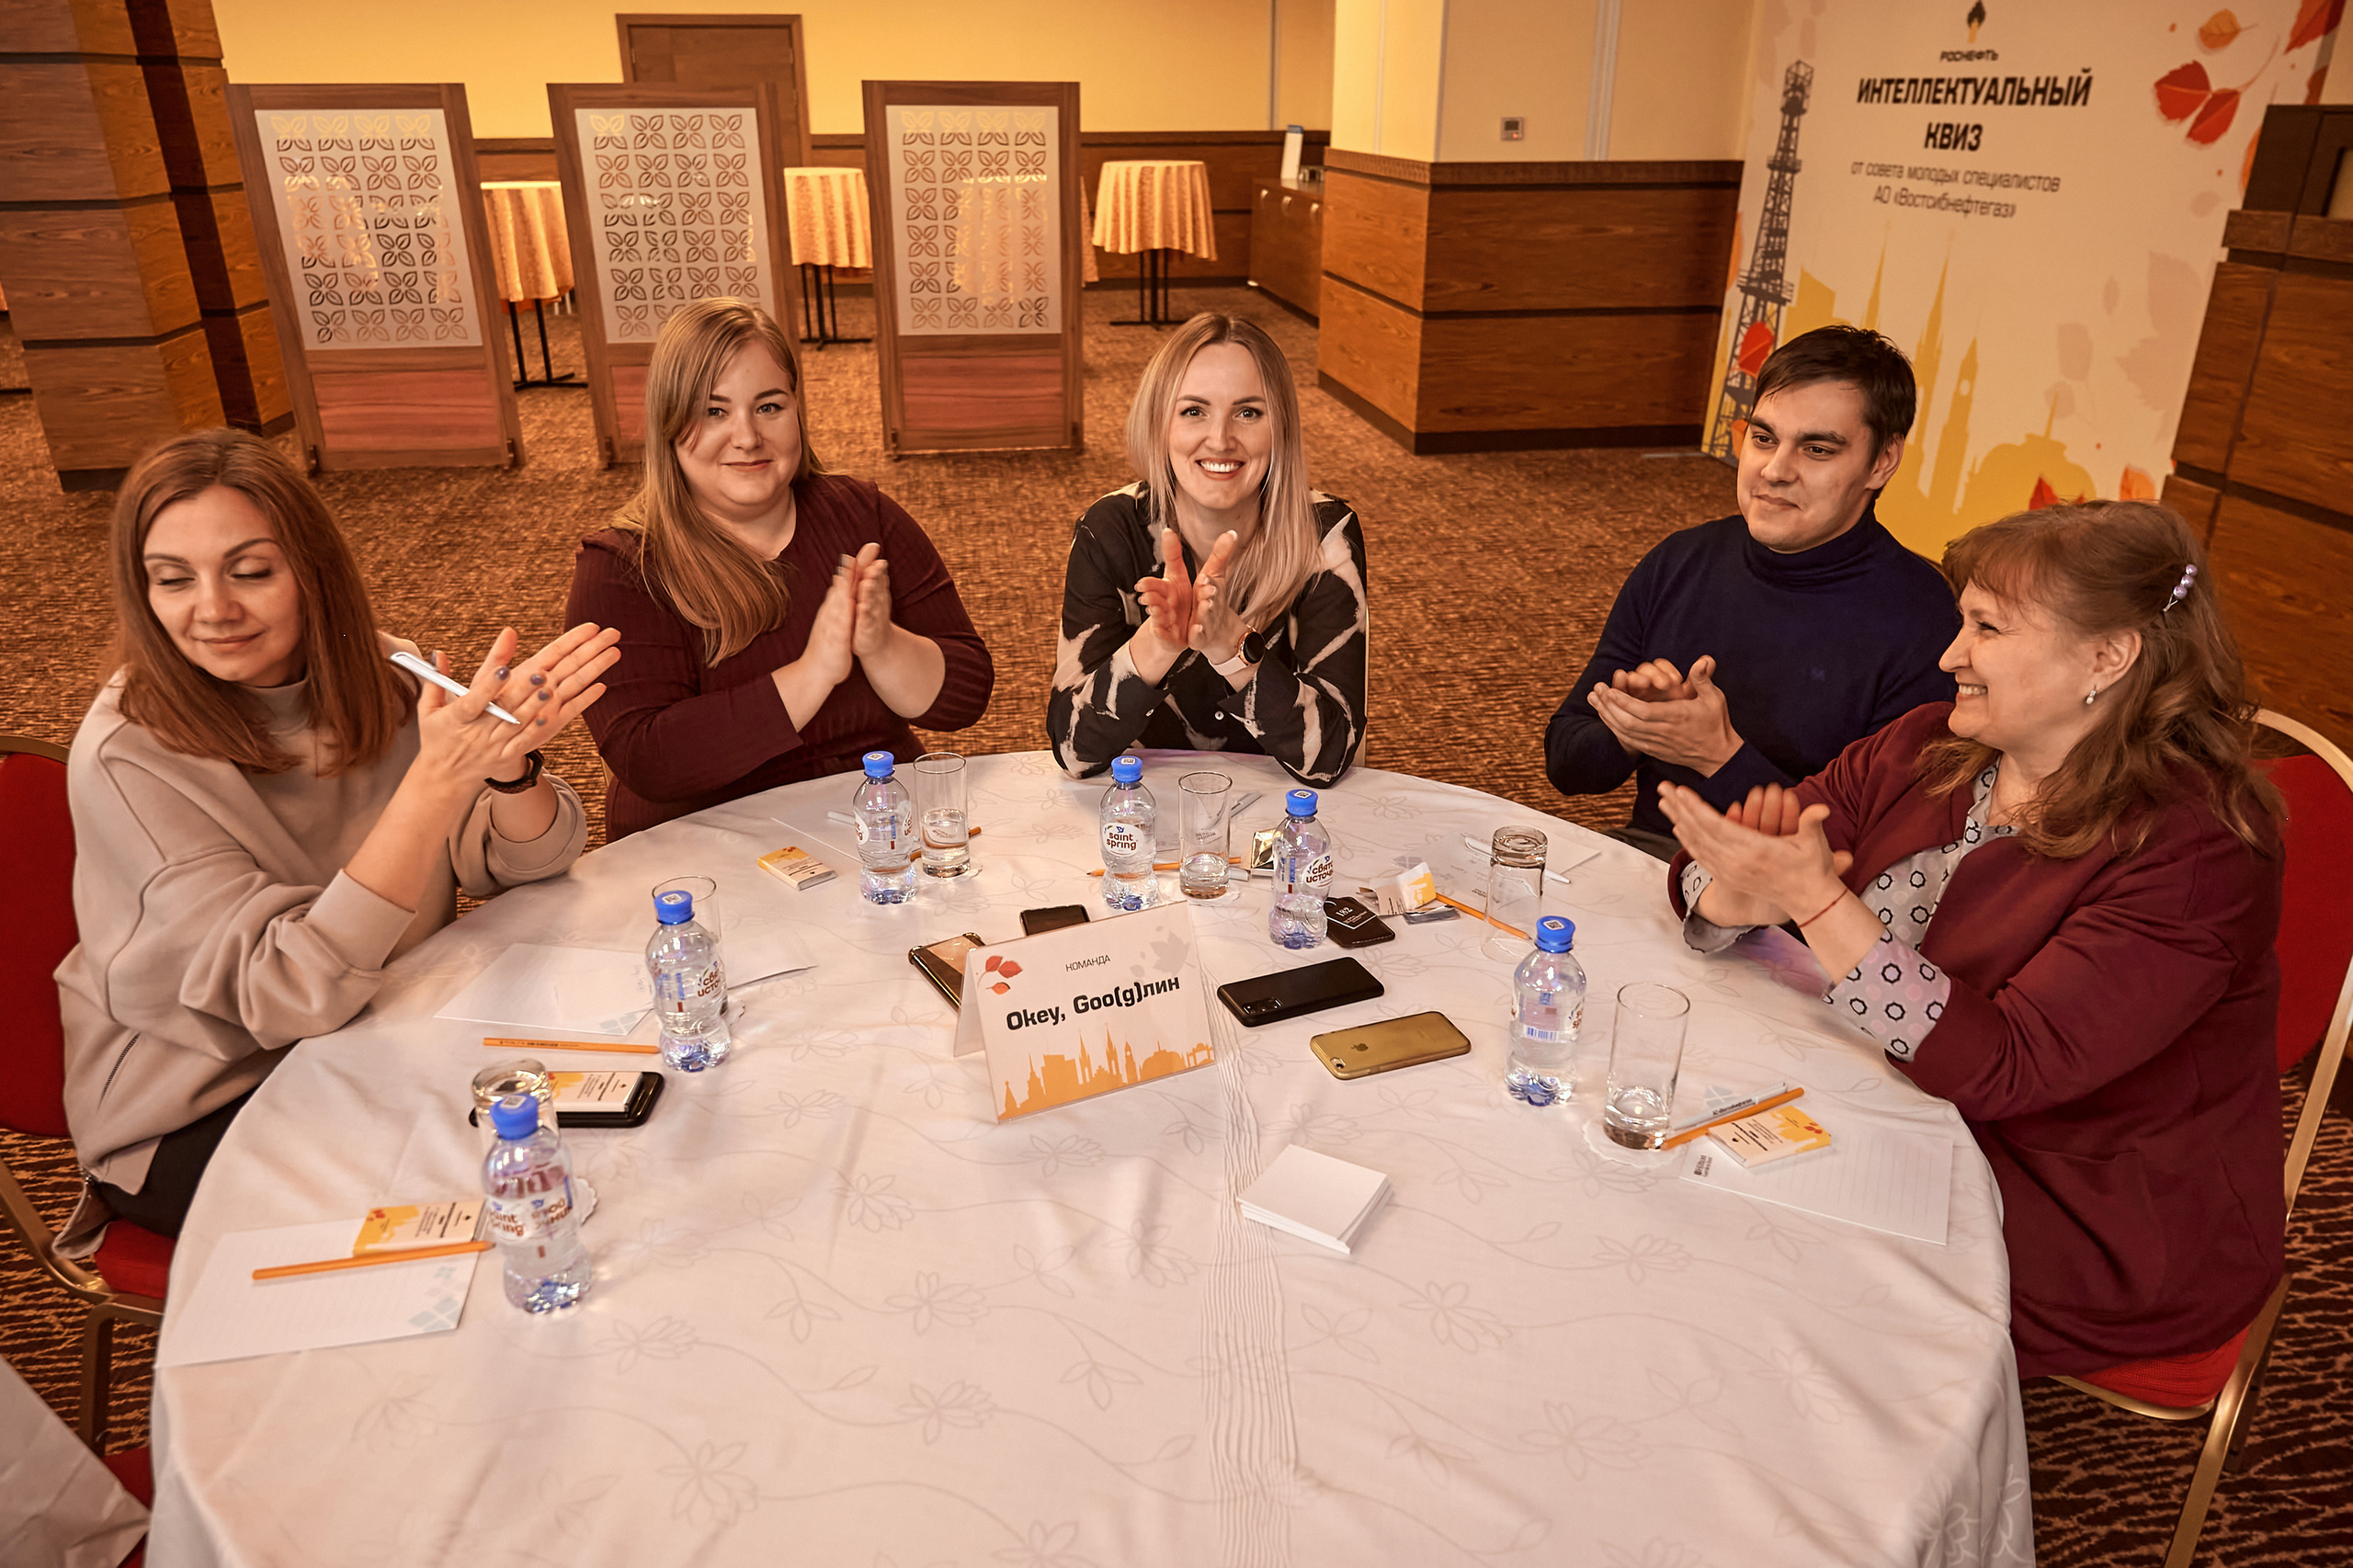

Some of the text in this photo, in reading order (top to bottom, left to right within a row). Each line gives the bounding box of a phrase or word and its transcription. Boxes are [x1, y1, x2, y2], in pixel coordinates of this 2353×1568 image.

[1939, 50, 1999, 62] РОСНЕФТЬ
[1857, 67, 2093, 107] ИНТЕЛЛЕКТУАЛЬНЫЙ
[1924, 122, 1983, 152] КВИЗ
[1850, 161, 2061, 193] от совета молодых специалистов
[1873, 185, 2017, 219] АО «Востсибнефтегаз»
[1107, 838, 1137, 851] spring
[1108, 832, 1134, 842] saint
[1065, 954, 1111, 972] КОМАНДА
[1006, 976, 1180, 1030] Okey, Goo(g)лин
